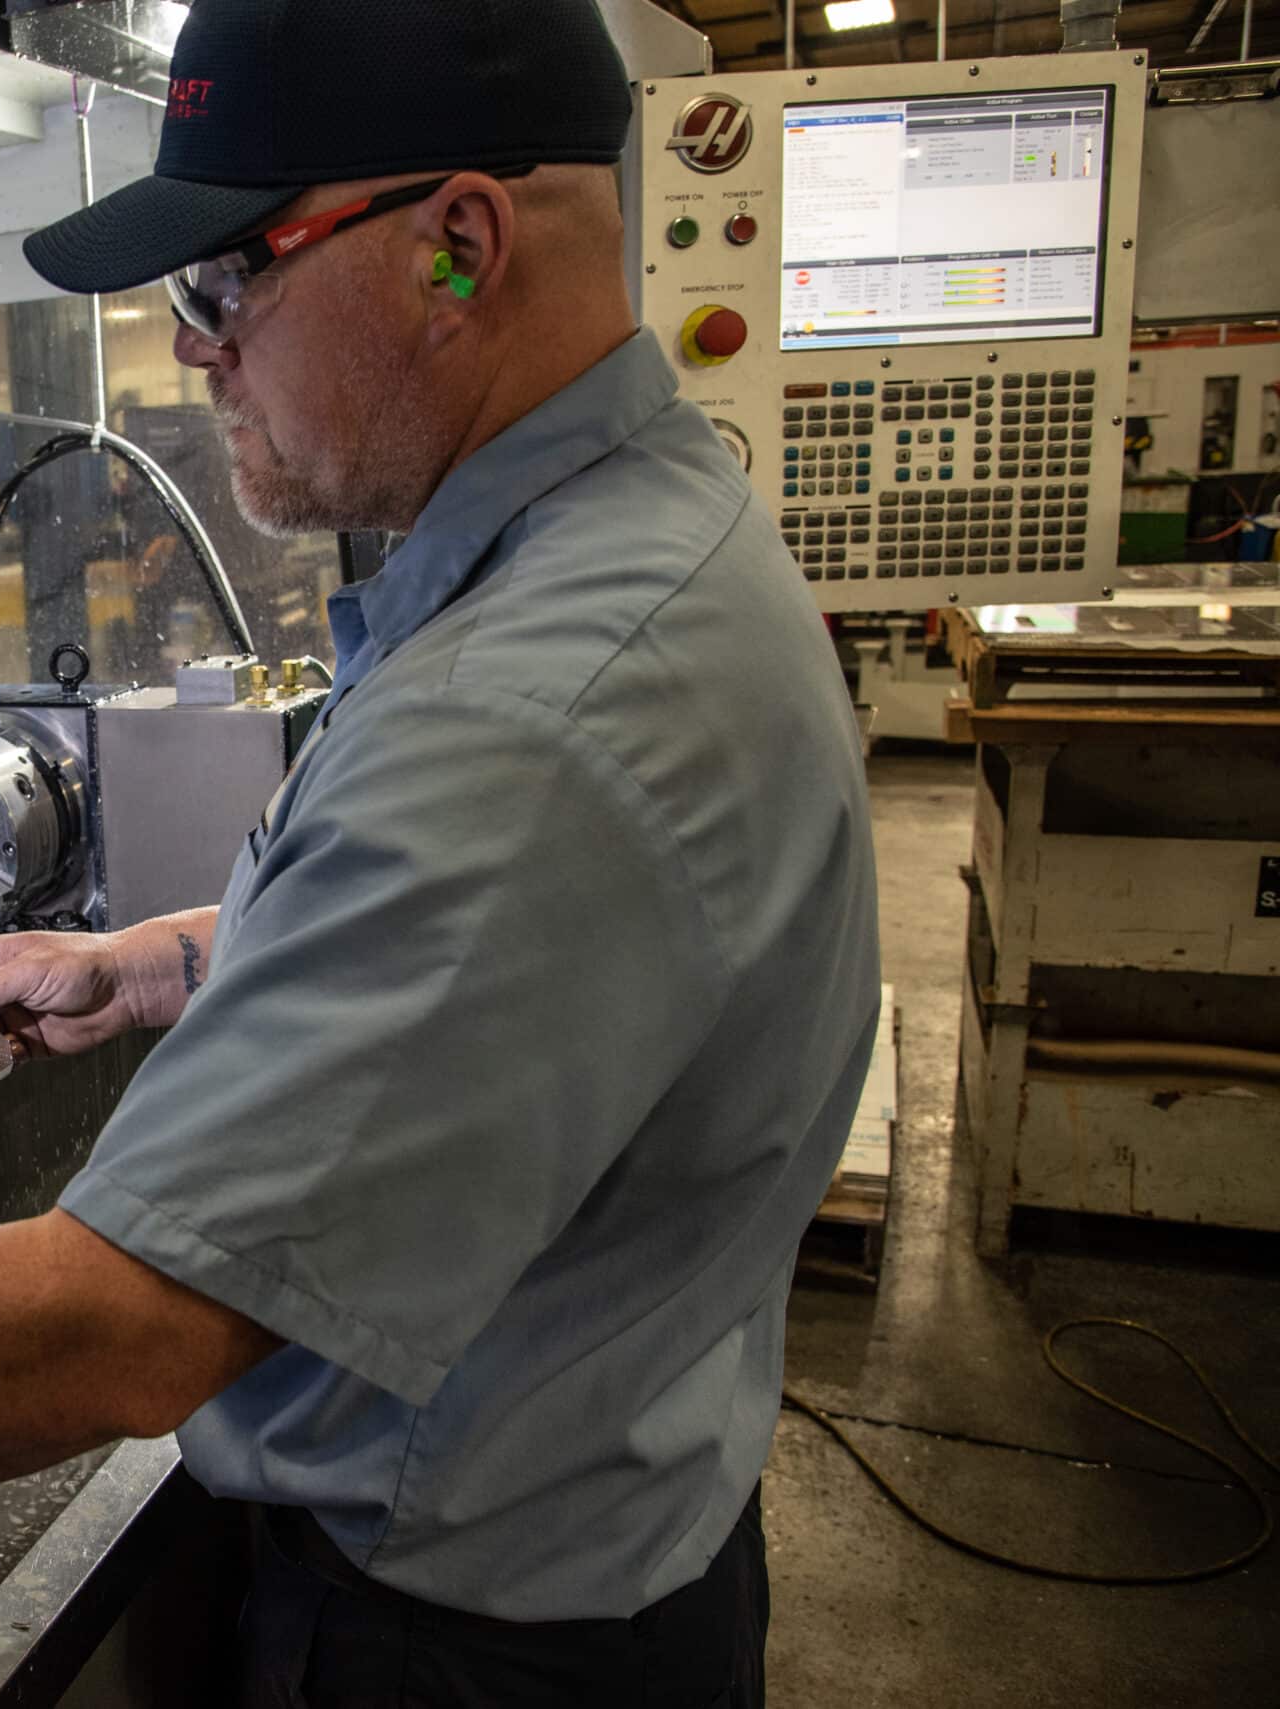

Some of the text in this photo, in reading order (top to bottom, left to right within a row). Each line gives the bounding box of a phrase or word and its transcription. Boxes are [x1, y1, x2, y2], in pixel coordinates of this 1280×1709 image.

[665, 193, 704, 202] POWER ON
[723, 189, 764, 199] POWER OFF
[681, 283, 745, 294] EMERGENCY STOP
[719, 398, 736, 406] JOG
